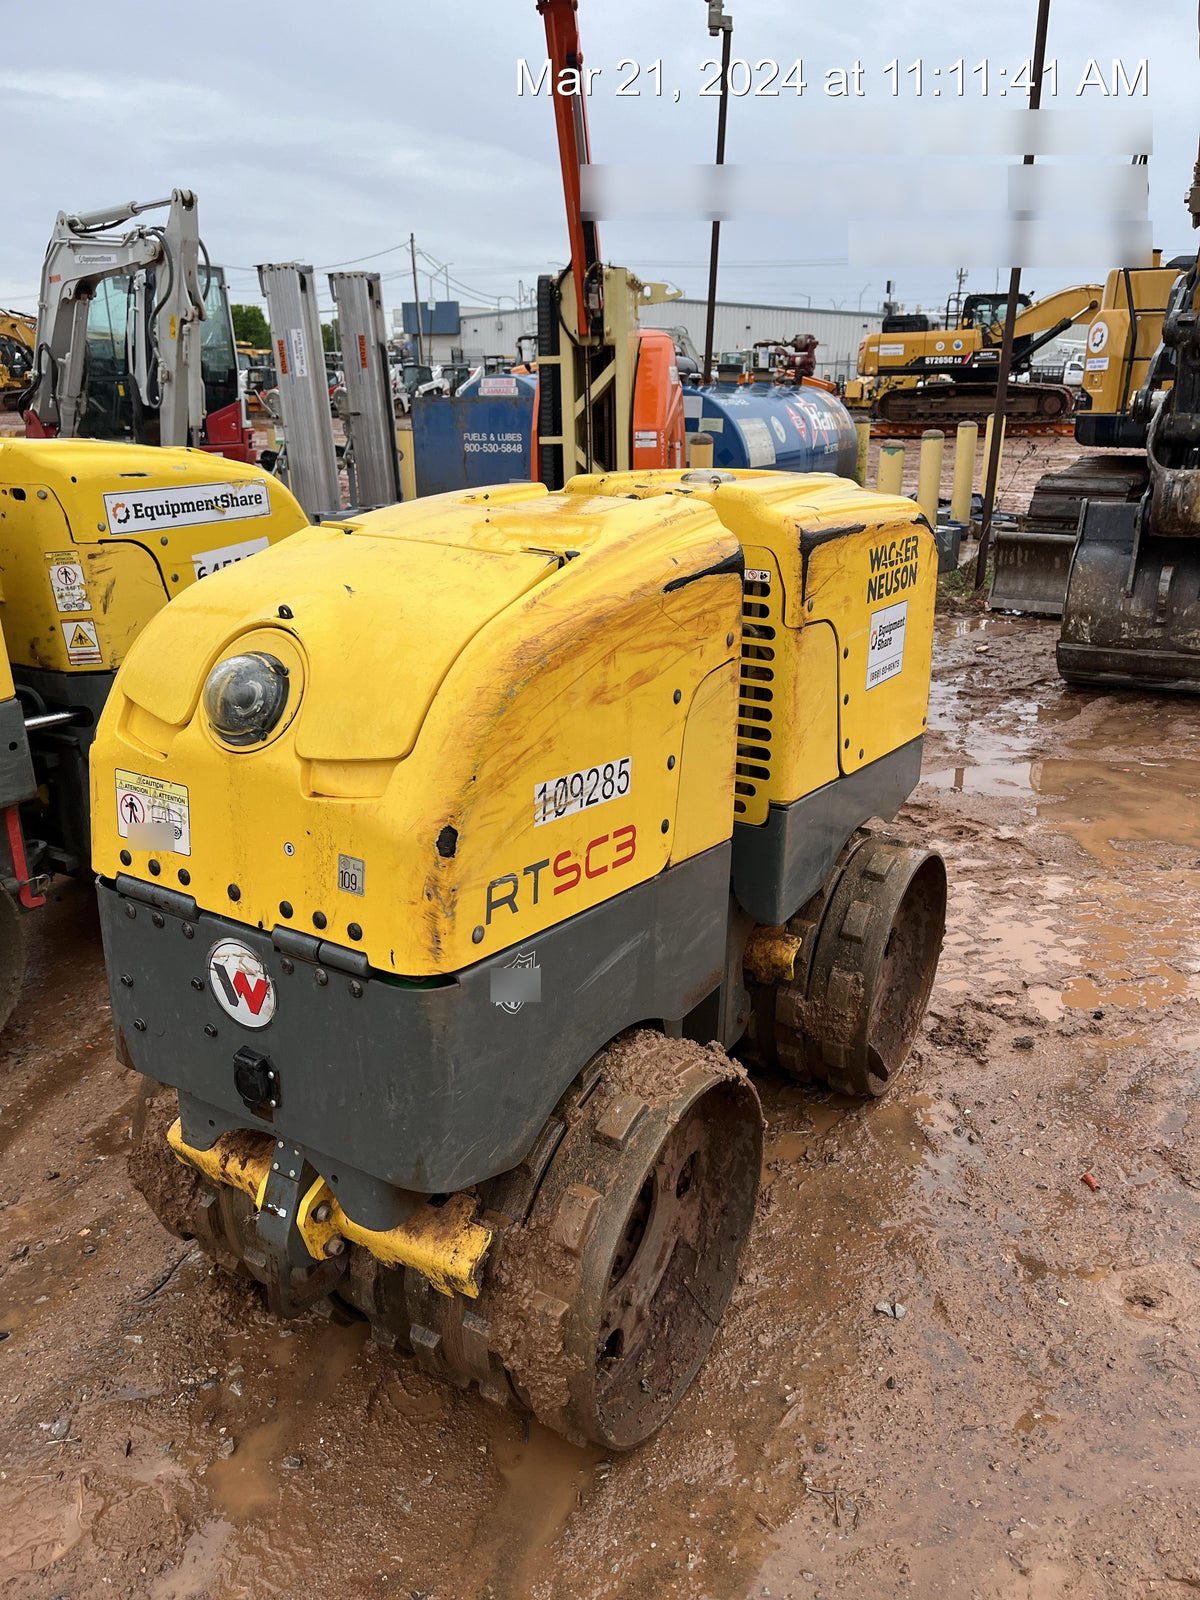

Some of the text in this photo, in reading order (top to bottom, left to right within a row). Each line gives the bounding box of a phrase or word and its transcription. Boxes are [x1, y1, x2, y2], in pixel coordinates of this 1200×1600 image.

[479, 387, 518, 395] FLAMMABLE
[463, 433, 522, 441] FUELS & LUBES
[464, 443, 523, 453] 800-530-5848
[132, 493, 263, 521] EquipmentShare
[869, 535, 919, 574] WACKER
[866, 561, 918, 605] NEUSON
[878, 615, 906, 638] Equipment
[877, 636, 893, 651] Share
[142, 778, 164, 790] CAUTION
[537, 757, 631, 822] 109285
[286, 845, 292, 853] 5
[339, 869, 358, 891] 109
